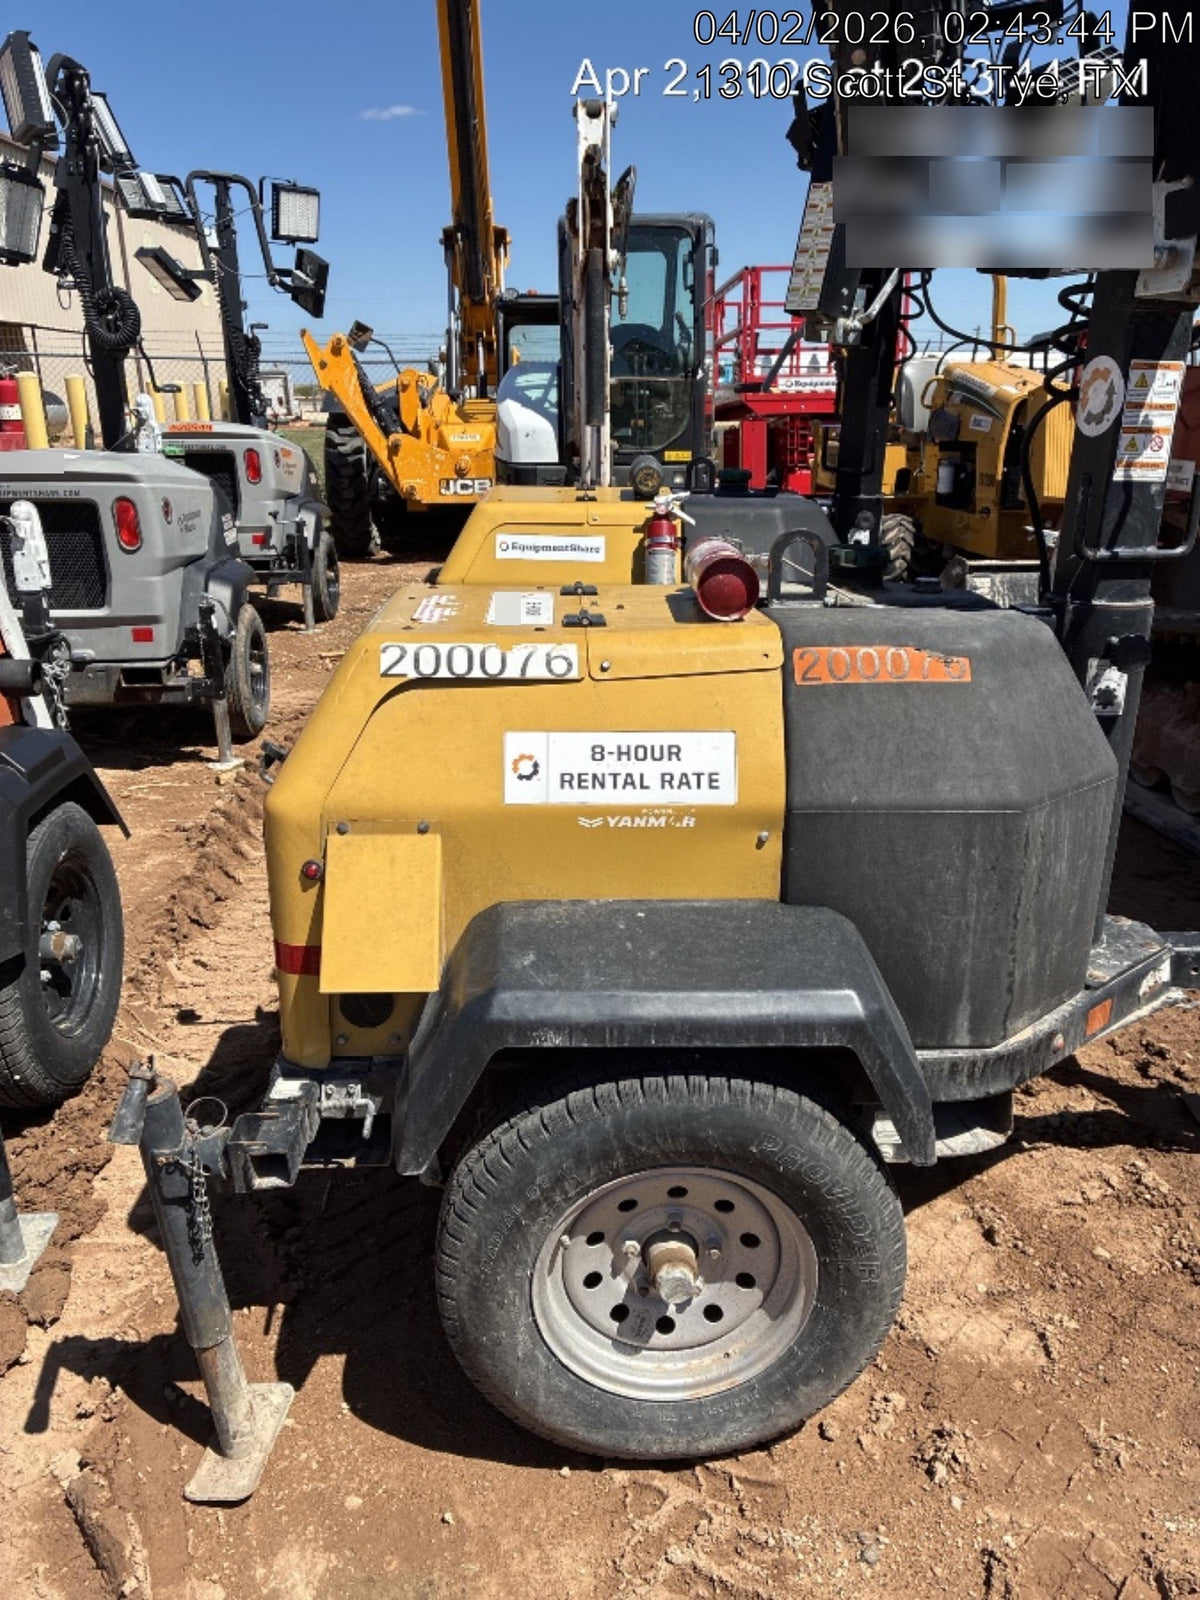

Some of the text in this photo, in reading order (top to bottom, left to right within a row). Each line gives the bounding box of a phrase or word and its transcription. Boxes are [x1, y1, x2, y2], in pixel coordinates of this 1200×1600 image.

[440, 477, 492, 495] JCB
[511, 541, 600, 554] EquipmentShare
[380, 644, 573, 678] 200076
[591, 744, 682, 762] 8-HOUR
[559, 772, 721, 790] RENTAL RATE
